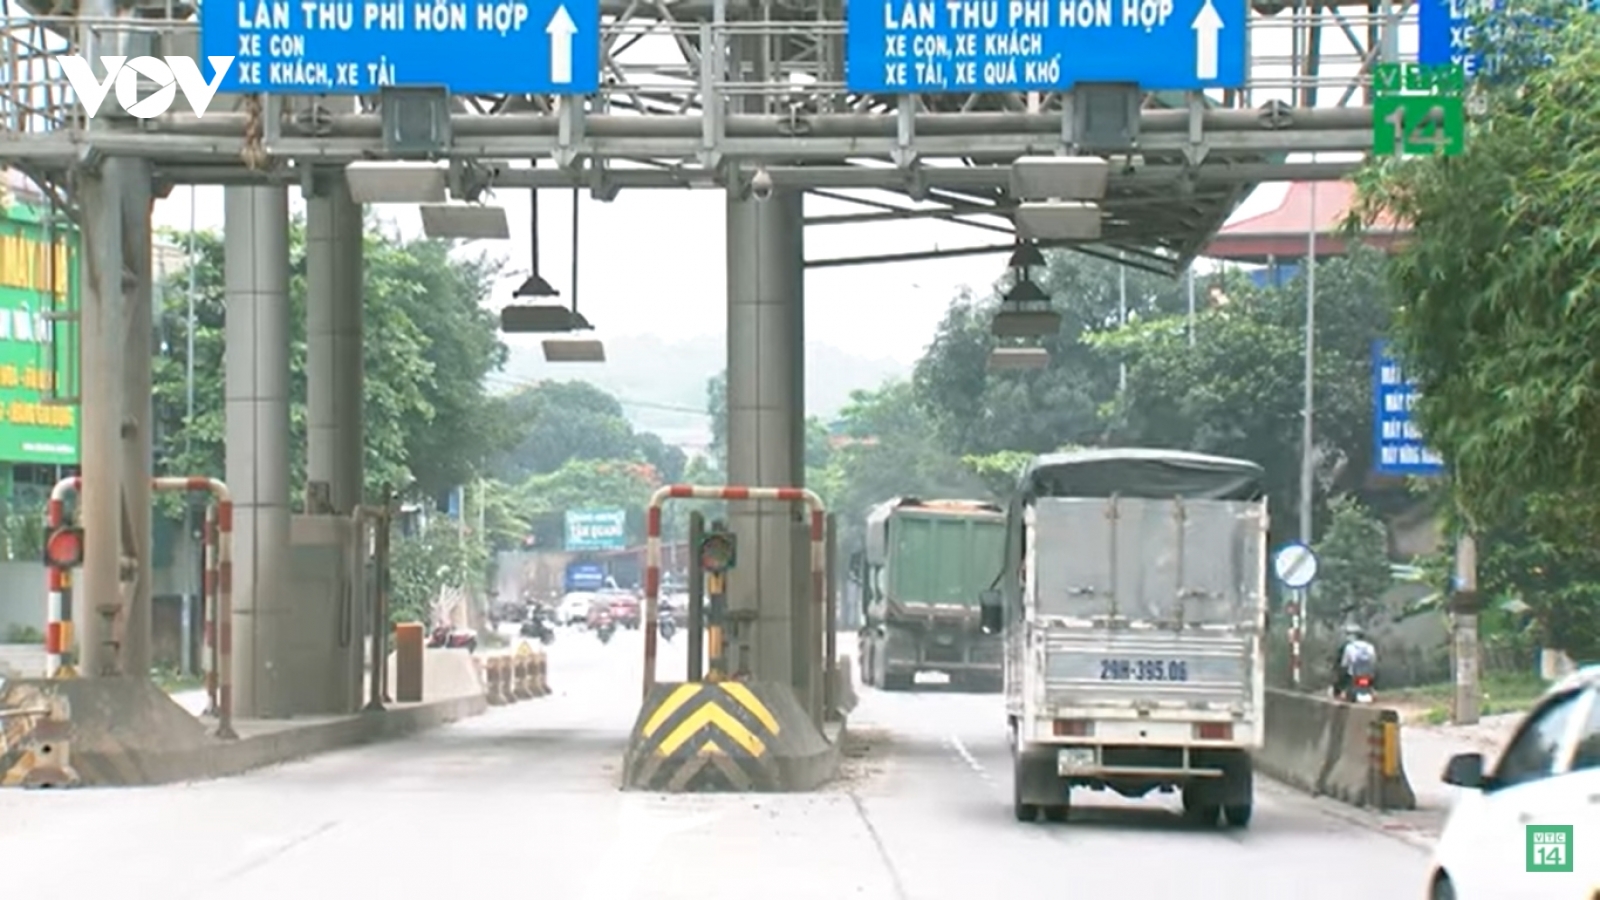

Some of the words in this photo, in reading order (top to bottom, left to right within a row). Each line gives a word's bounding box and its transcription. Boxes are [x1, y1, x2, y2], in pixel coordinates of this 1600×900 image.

[301, 2, 353, 30] THU
[476, 0, 528, 37] HỢP
[946, 0, 998, 29] THU
[238, 34, 262, 56] XE
[269, 34, 305, 57] CON
[885, 35, 907, 57] XE
[955, 33, 977, 56] XE
[985, 29, 1042, 56] KHÁCH
[238, 61, 262, 84] XE
[336, 63, 359, 86] XE
[367, 55, 396, 86] TẢI
[885, 62, 907, 85] XE
[955, 62, 977, 84] XE
[983, 57, 1018, 86] QUÁ
